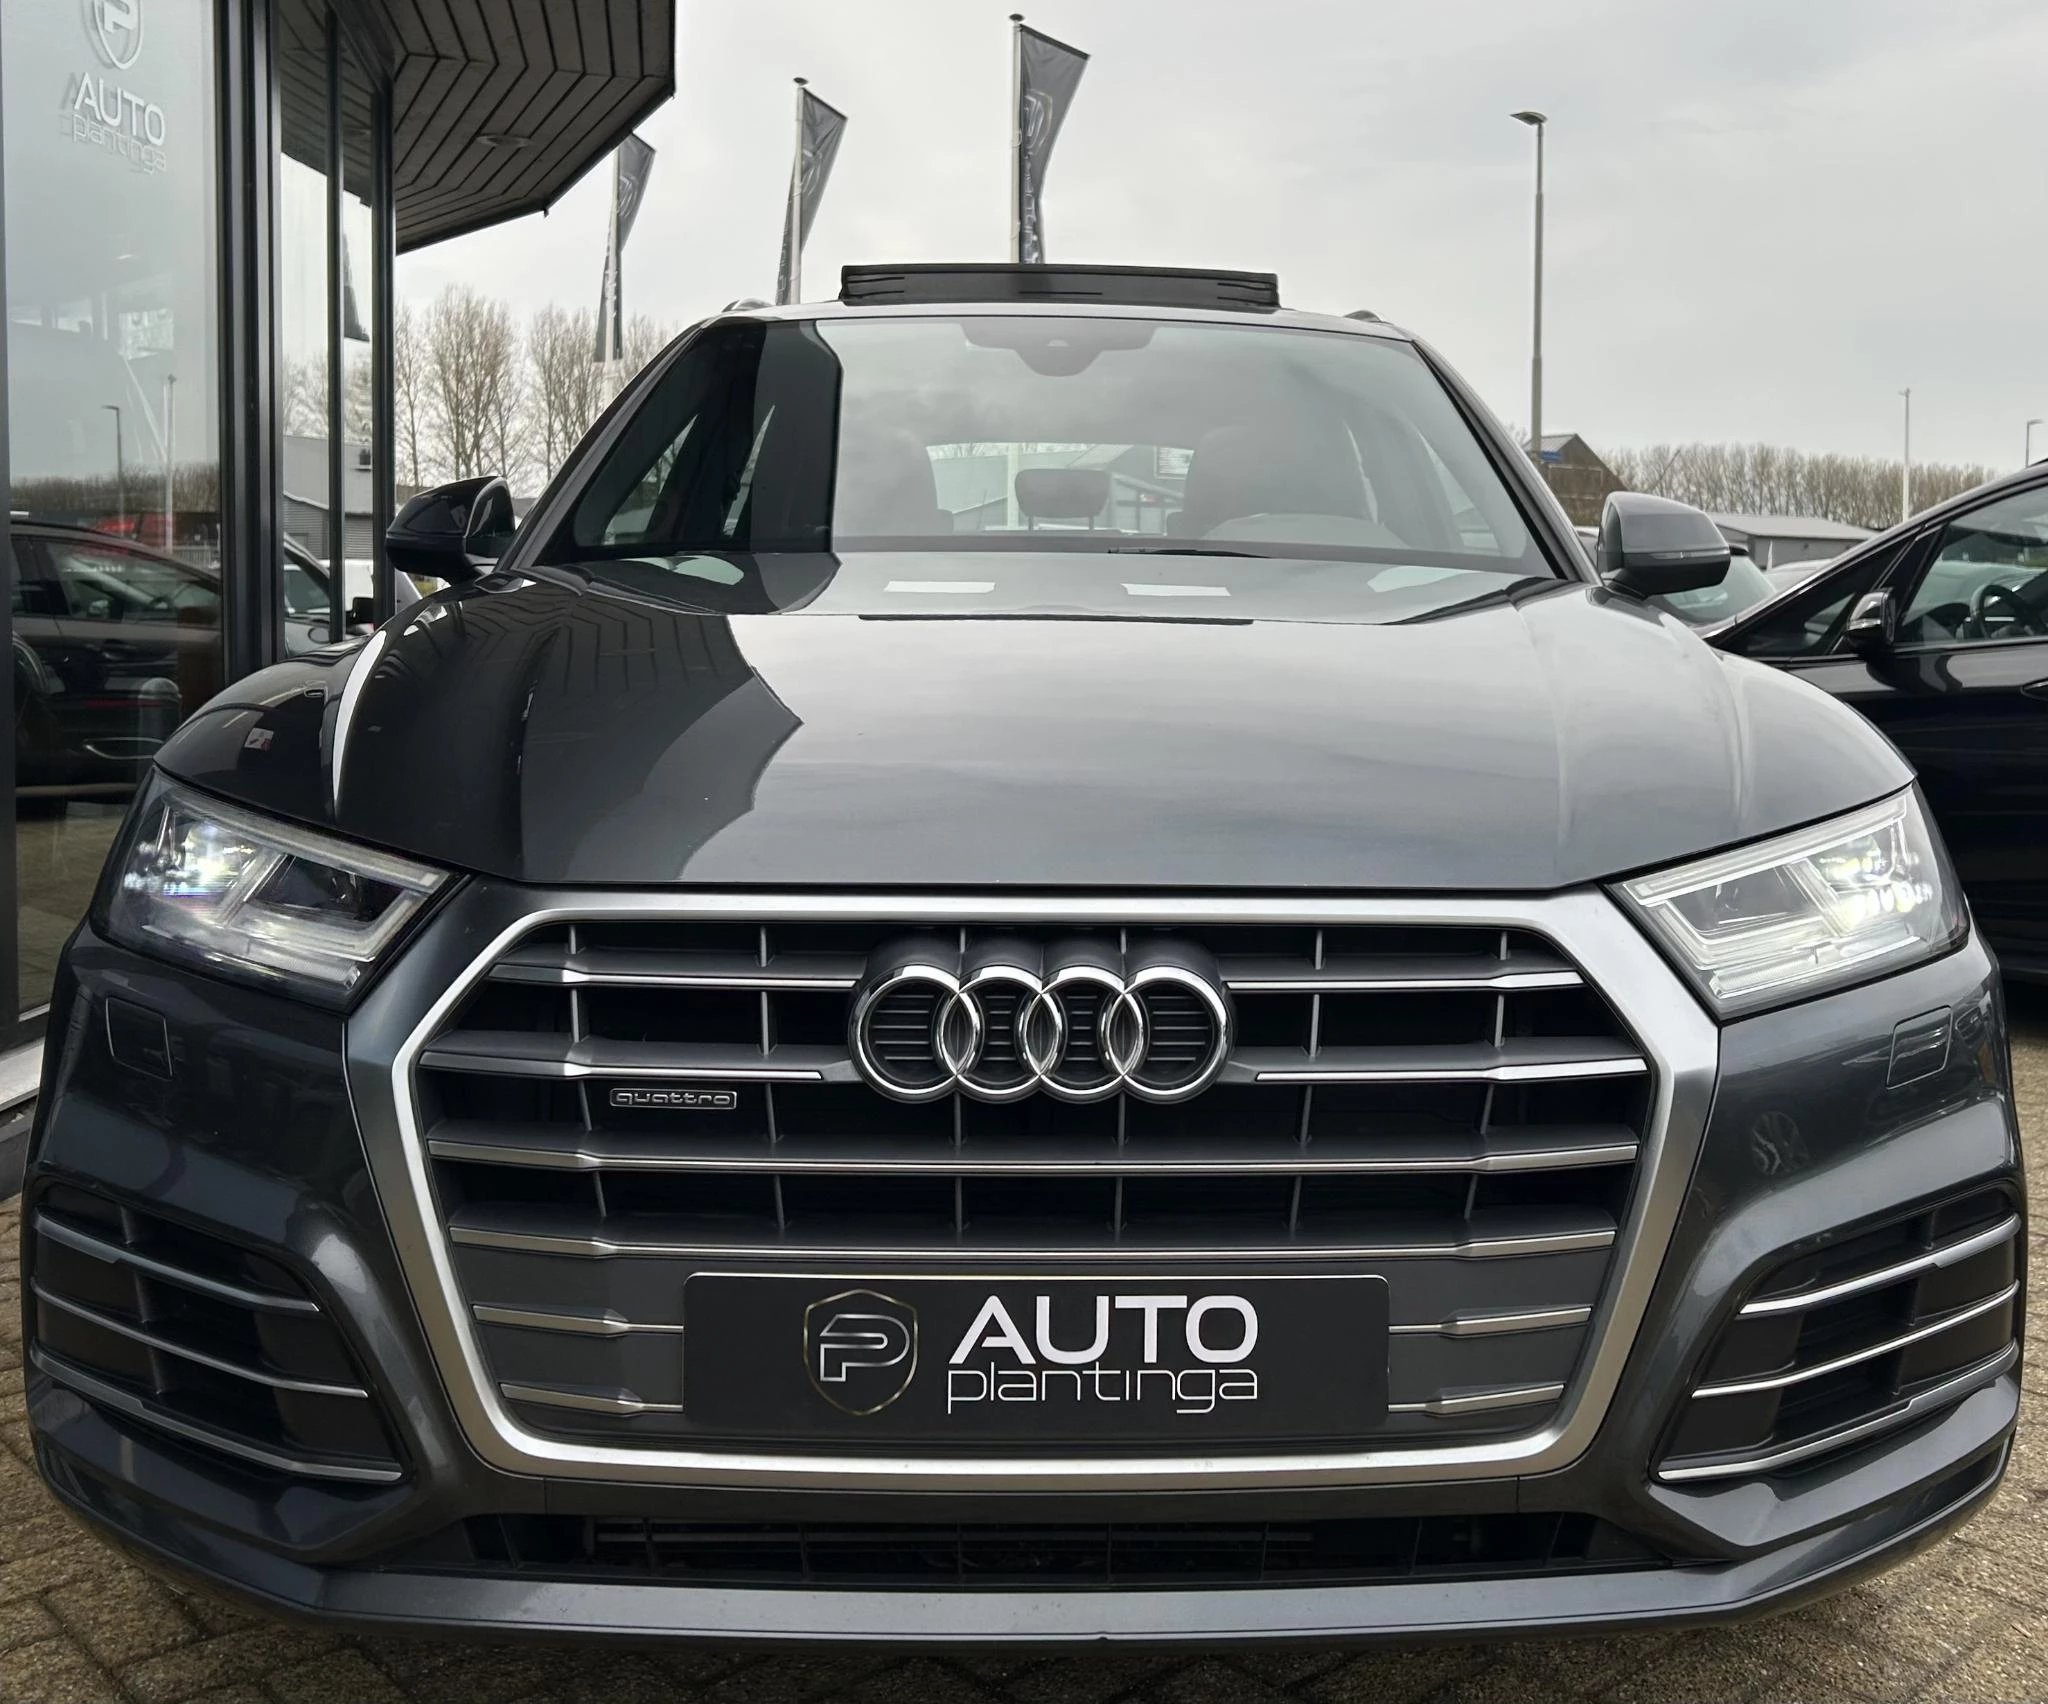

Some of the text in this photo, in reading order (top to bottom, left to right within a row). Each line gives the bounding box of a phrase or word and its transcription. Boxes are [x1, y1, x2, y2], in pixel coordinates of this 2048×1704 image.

[73, 71, 166, 147] AUTO
[616, 1092, 730, 1106] quattro
[948, 1295, 1258, 1364] AUTO
[947, 1361, 1258, 1414] plantinga
